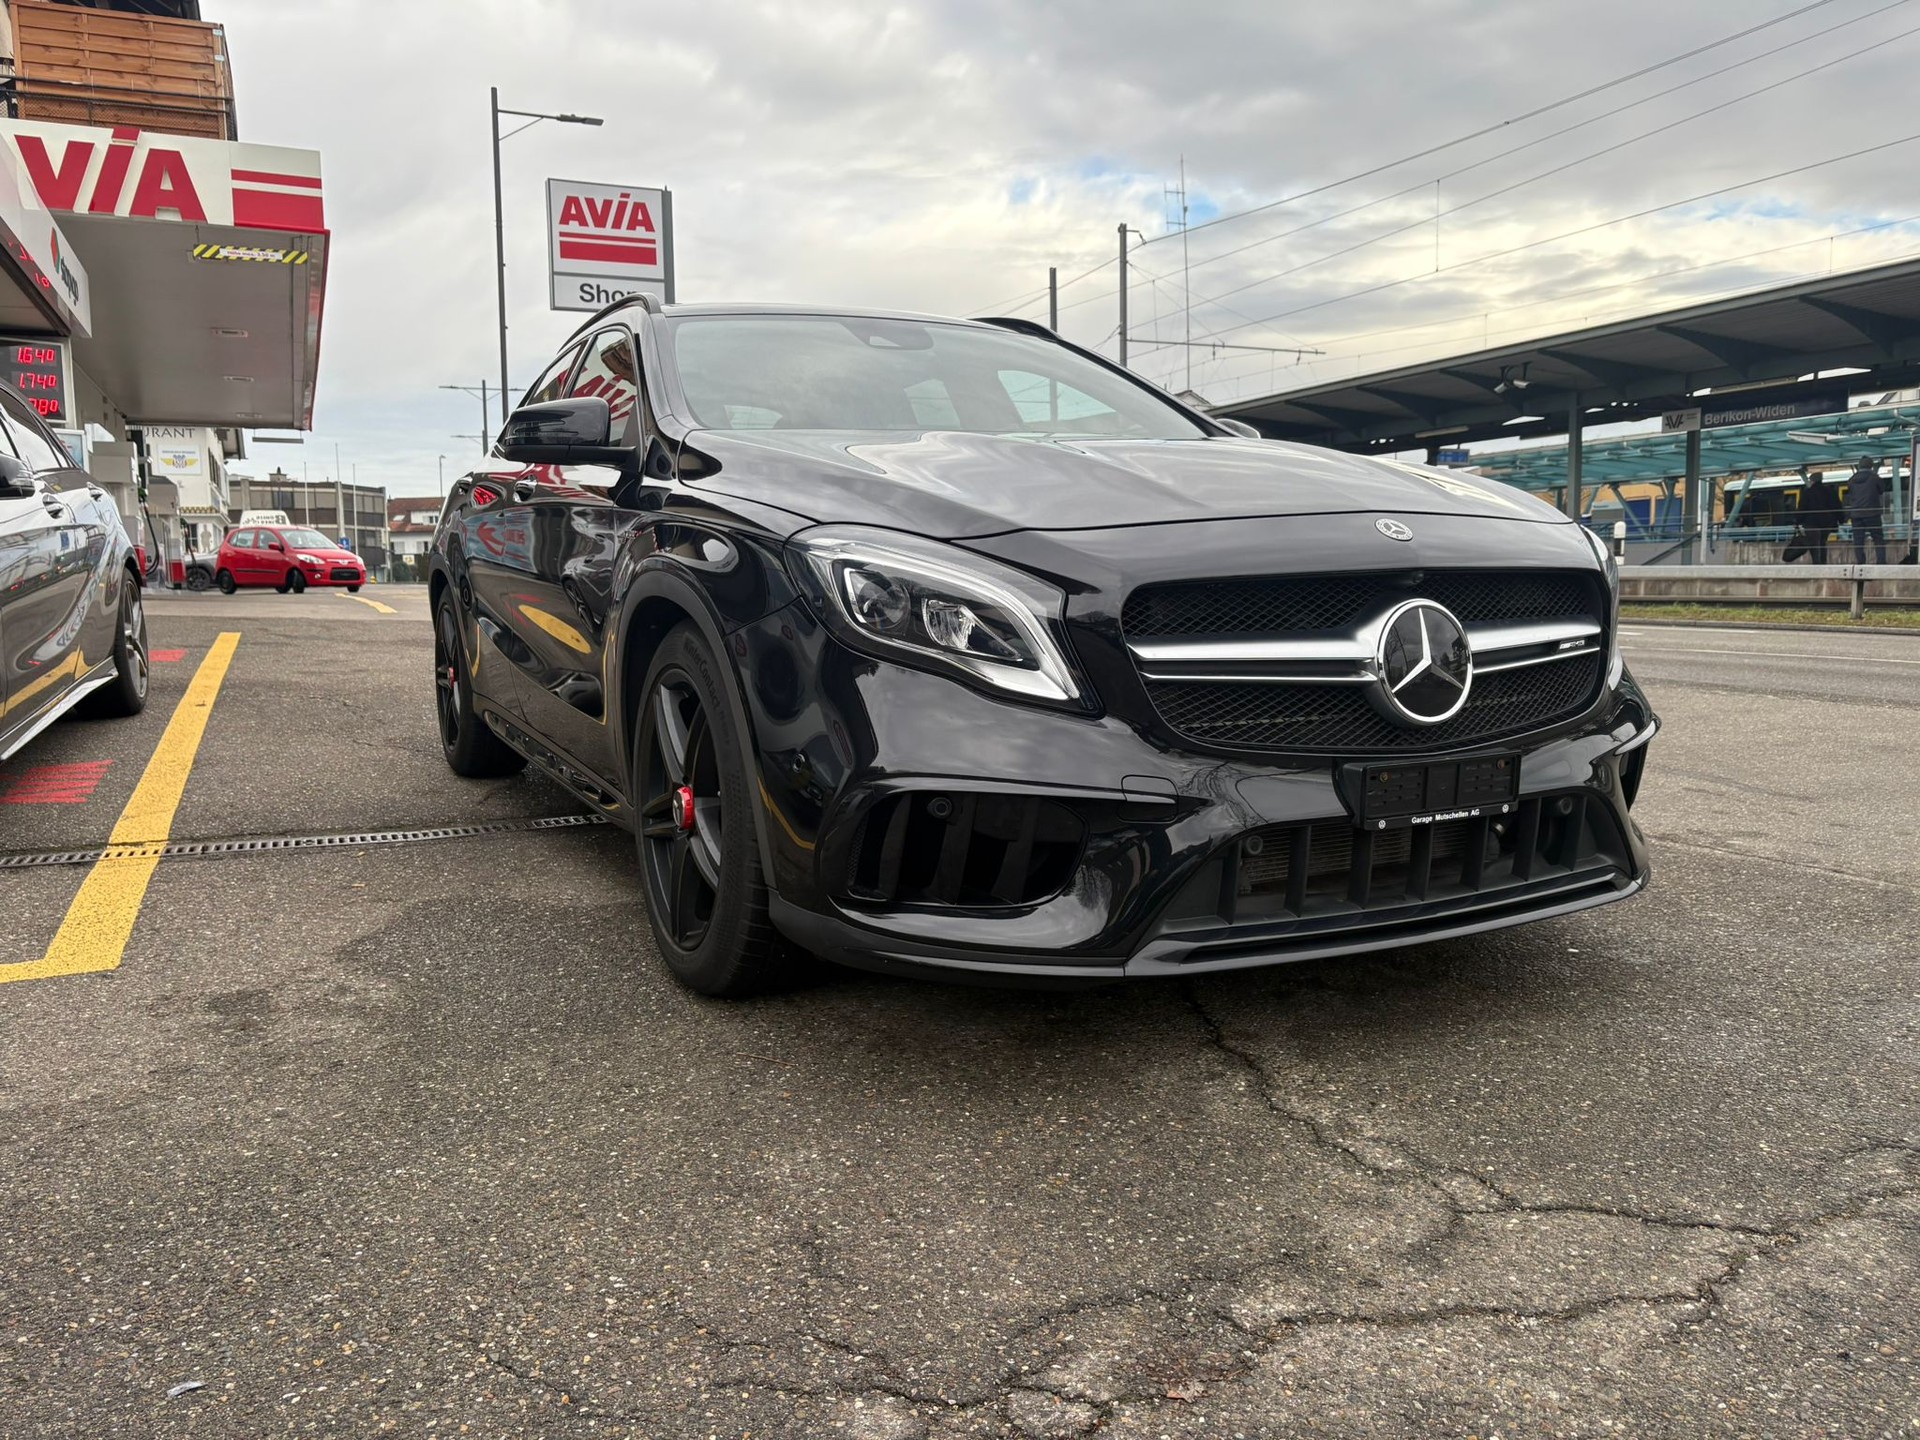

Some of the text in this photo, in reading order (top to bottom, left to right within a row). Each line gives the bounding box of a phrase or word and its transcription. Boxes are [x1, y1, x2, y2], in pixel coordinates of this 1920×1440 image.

[559, 192, 656, 233] AVIA
[579, 283, 638, 304] Sho
[1704, 404, 1796, 425] Berikon-Widen
[1411, 813, 1433, 825] Garage
[1470, 808, 1480, 817] AG
